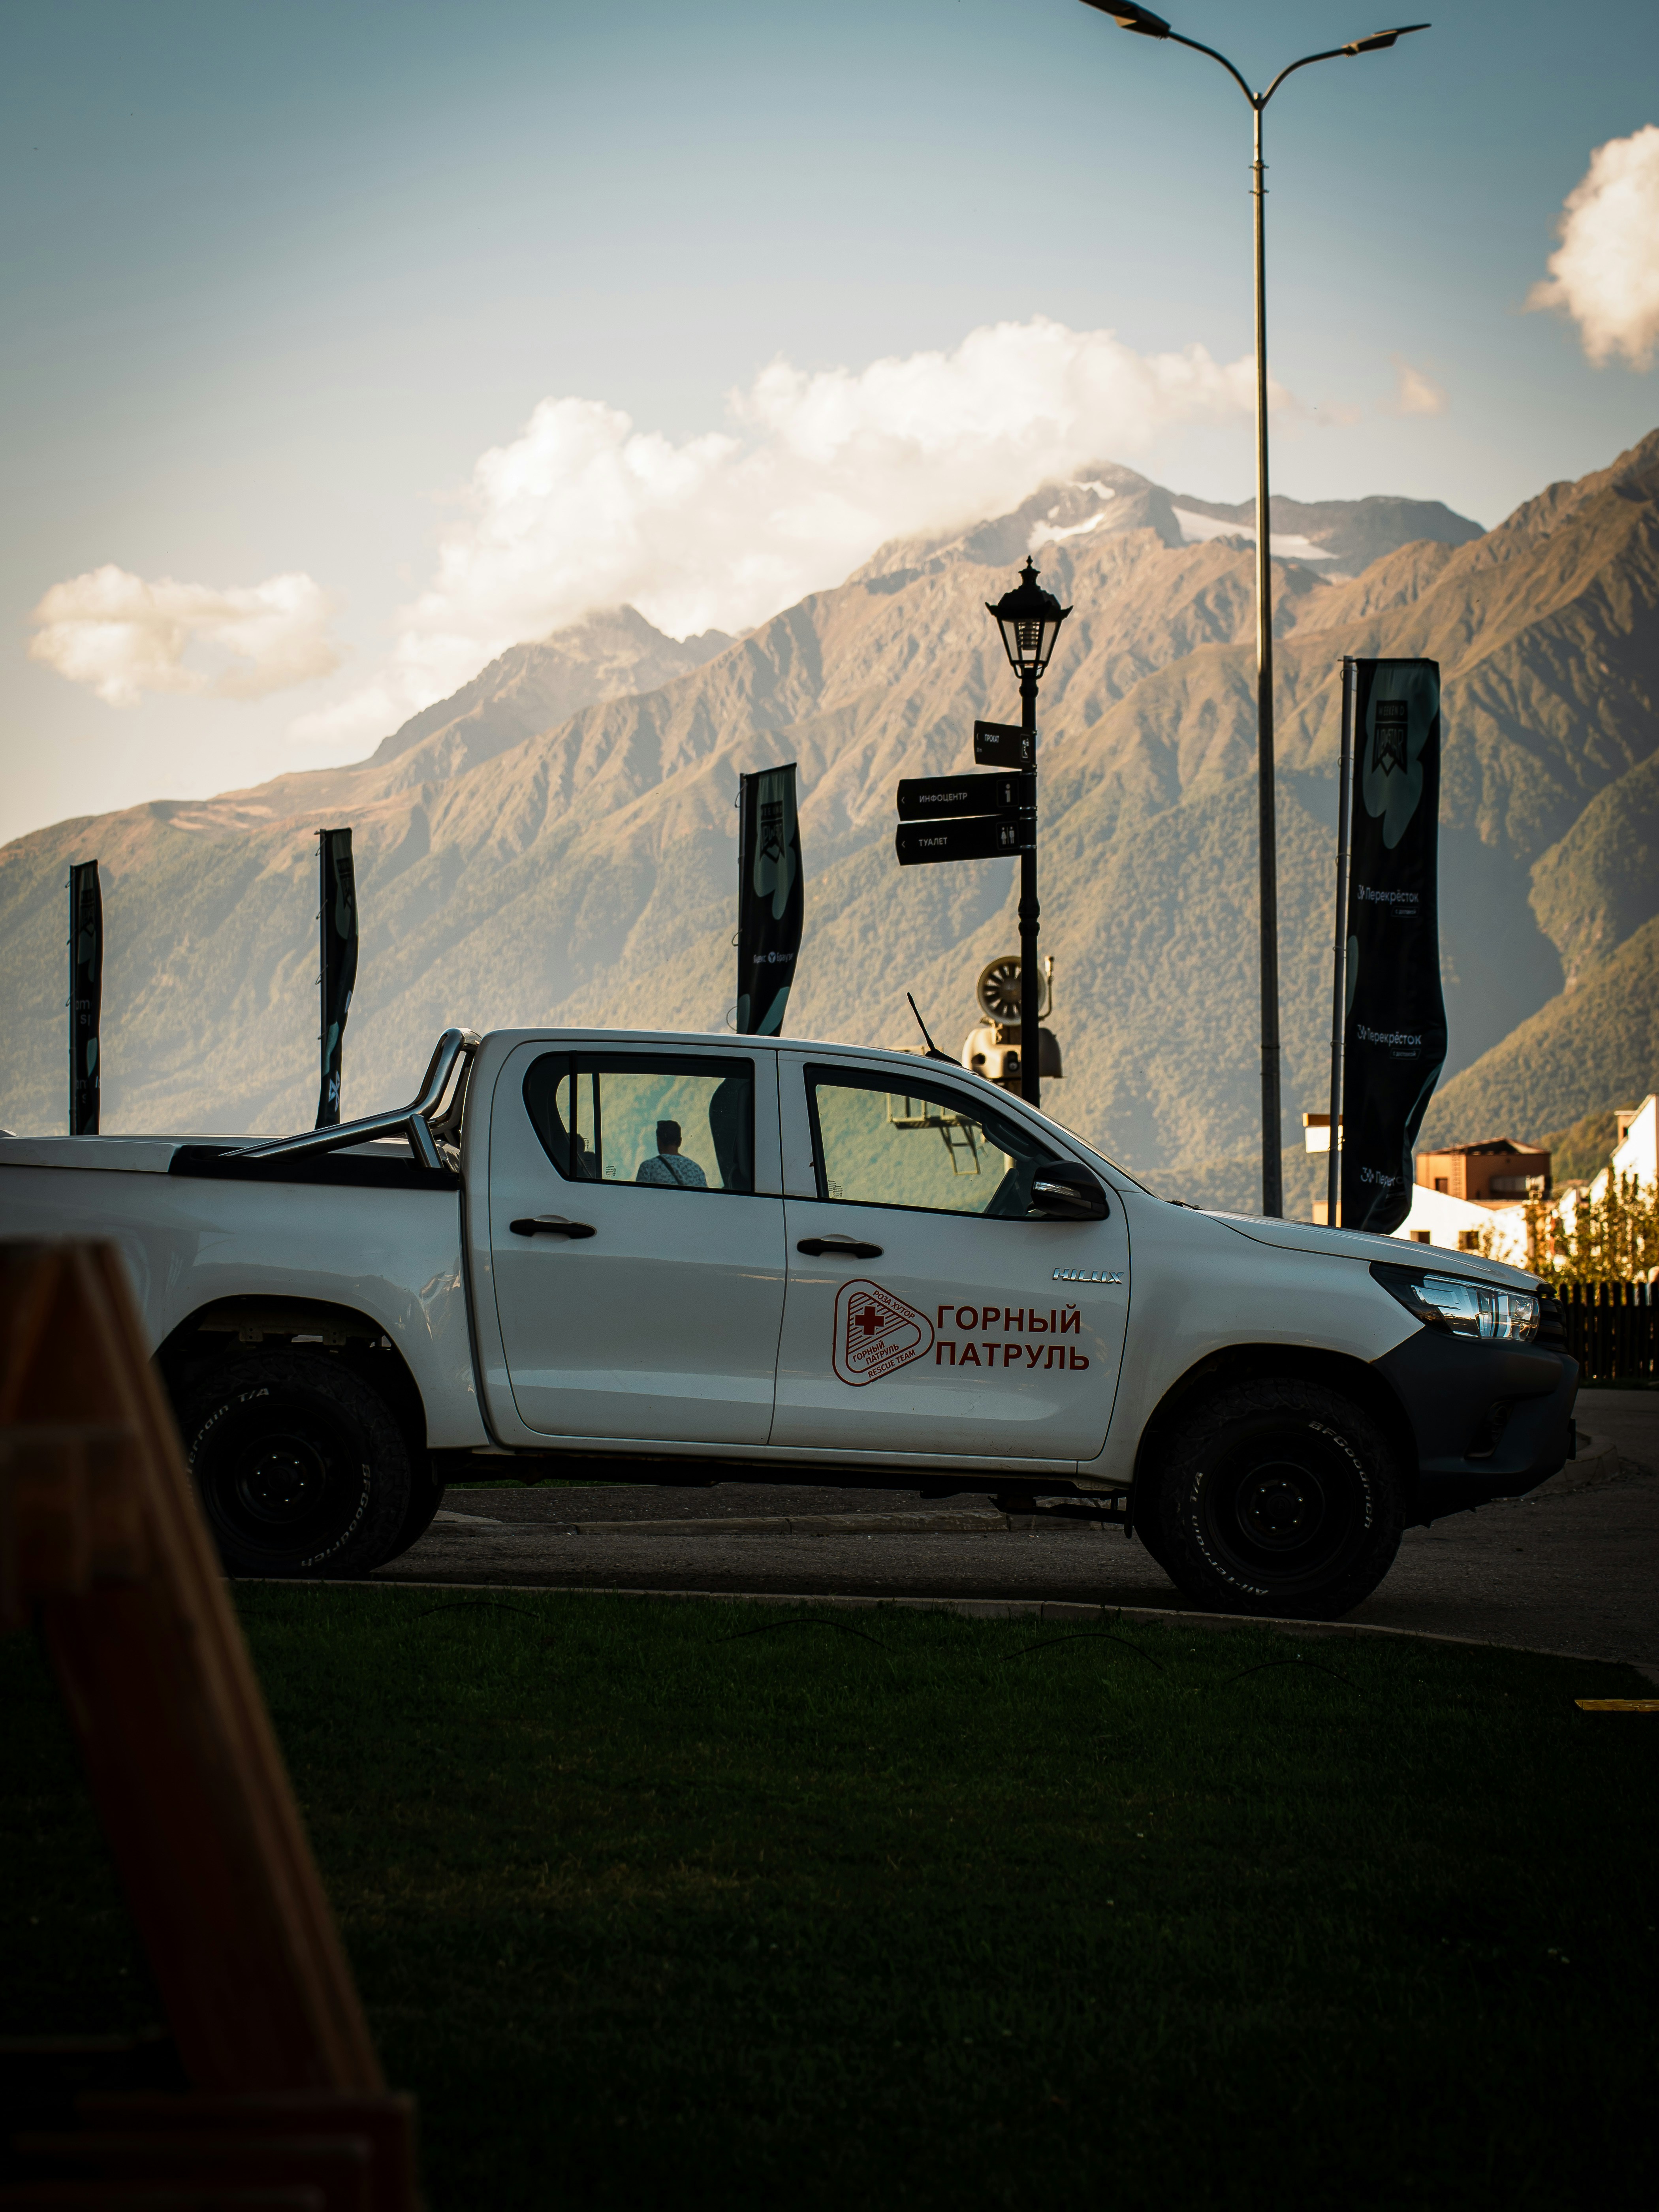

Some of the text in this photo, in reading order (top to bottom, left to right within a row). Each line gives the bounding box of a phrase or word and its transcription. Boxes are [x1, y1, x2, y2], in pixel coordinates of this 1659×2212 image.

[984, 734, 1000, 743] ПРОКАТ
[919, 792, 968, 803] ИНФОЦЕНТР
[918, 837, 948, 847] ТУАЛЕТ
[1365, 886, 1419, 905] Перекрёсток
[1053, 1267, 1125, 1285] HILUX
[872, 1290, 915, 1319] РОЗА ХУТОР
[937, 1304, 1080, 1334] ГОРНЫЙ
[852, 1339, 885, 1363] ГОРНЫЙ
[865, 1344, 899, 1365] ПАТРУЛЬ
[936, 1341, 1089, 1370] ПАТРУЛЬ
[867, 1349, 916, 1378] RESCUE TEAM
[237, 1387, 271, 1403] T/A
[1308, 1420, 1374, 1529] BFGoodrich
[301, 1463, 371, 1567] BFGoodrich
[1189, 1471, 1270, 1596] All-Terrain T/A
